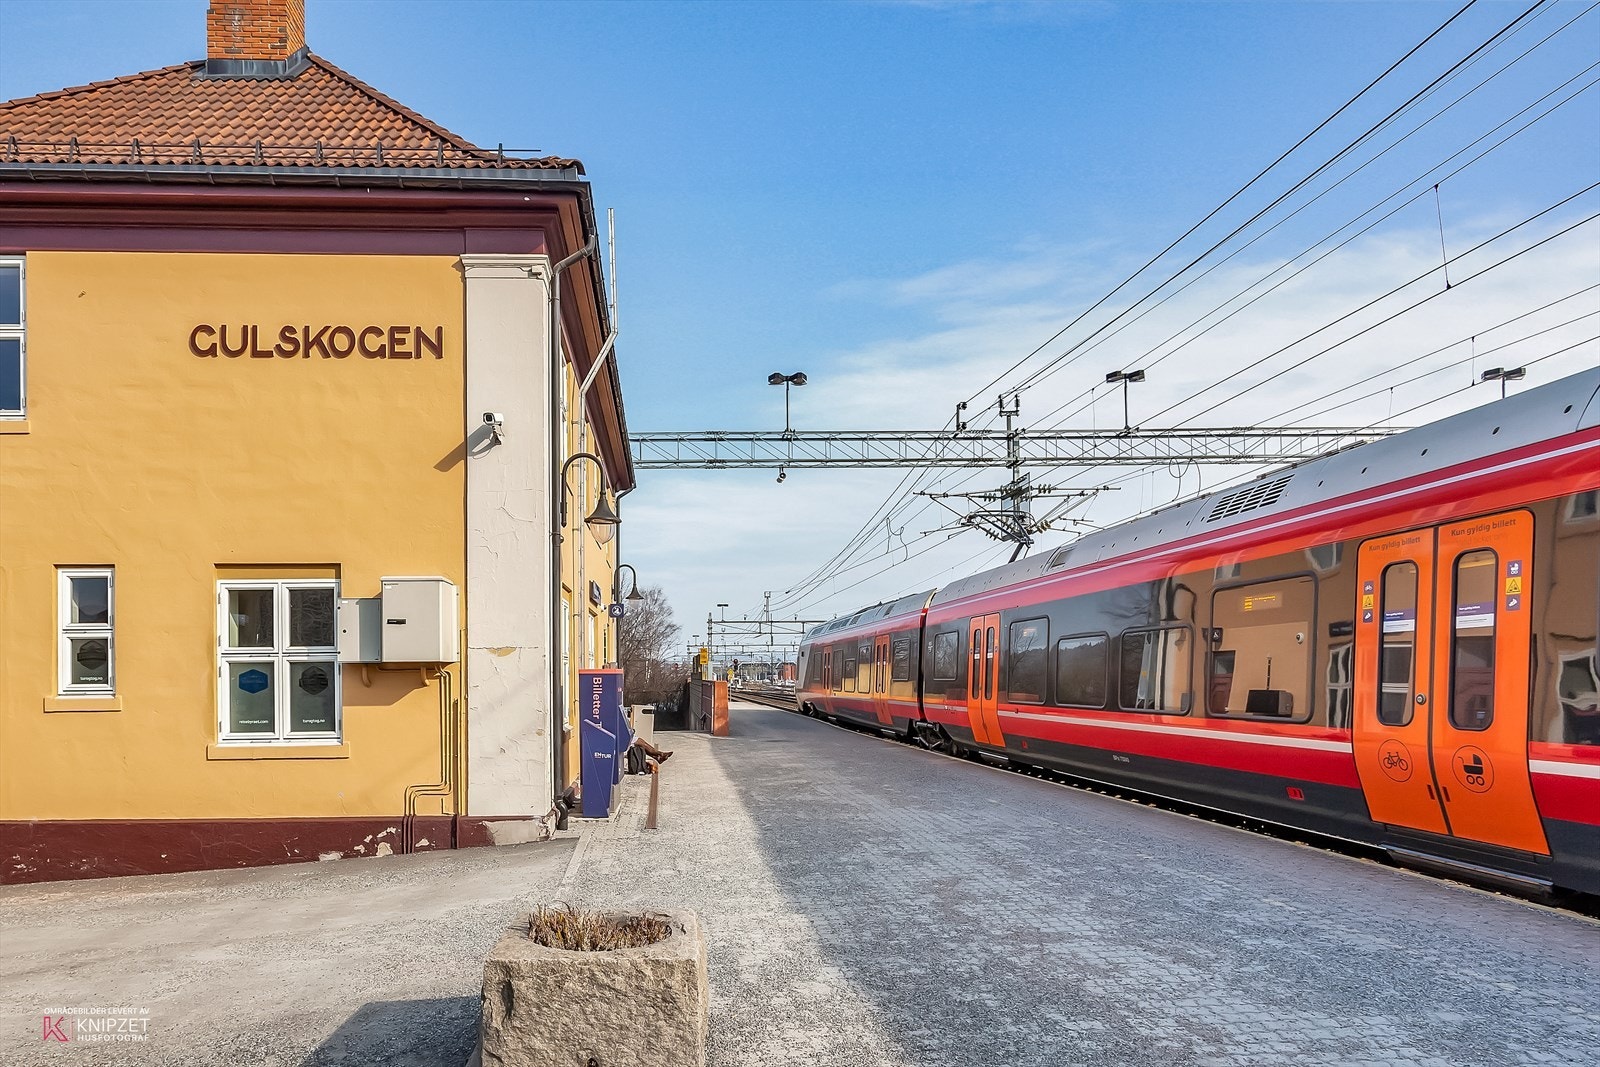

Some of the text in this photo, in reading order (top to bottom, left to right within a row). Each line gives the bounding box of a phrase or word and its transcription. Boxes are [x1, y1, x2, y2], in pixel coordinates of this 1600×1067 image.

[188, 324, 444, 359] GULSKOGEN
[1451, 519, 1516, 536] Kun gyldig billett
[1381, 541, 1400, 551] gyldig
[1402, 537, 1421, 546] billett
[592, 677, 603, 720] Billetter
